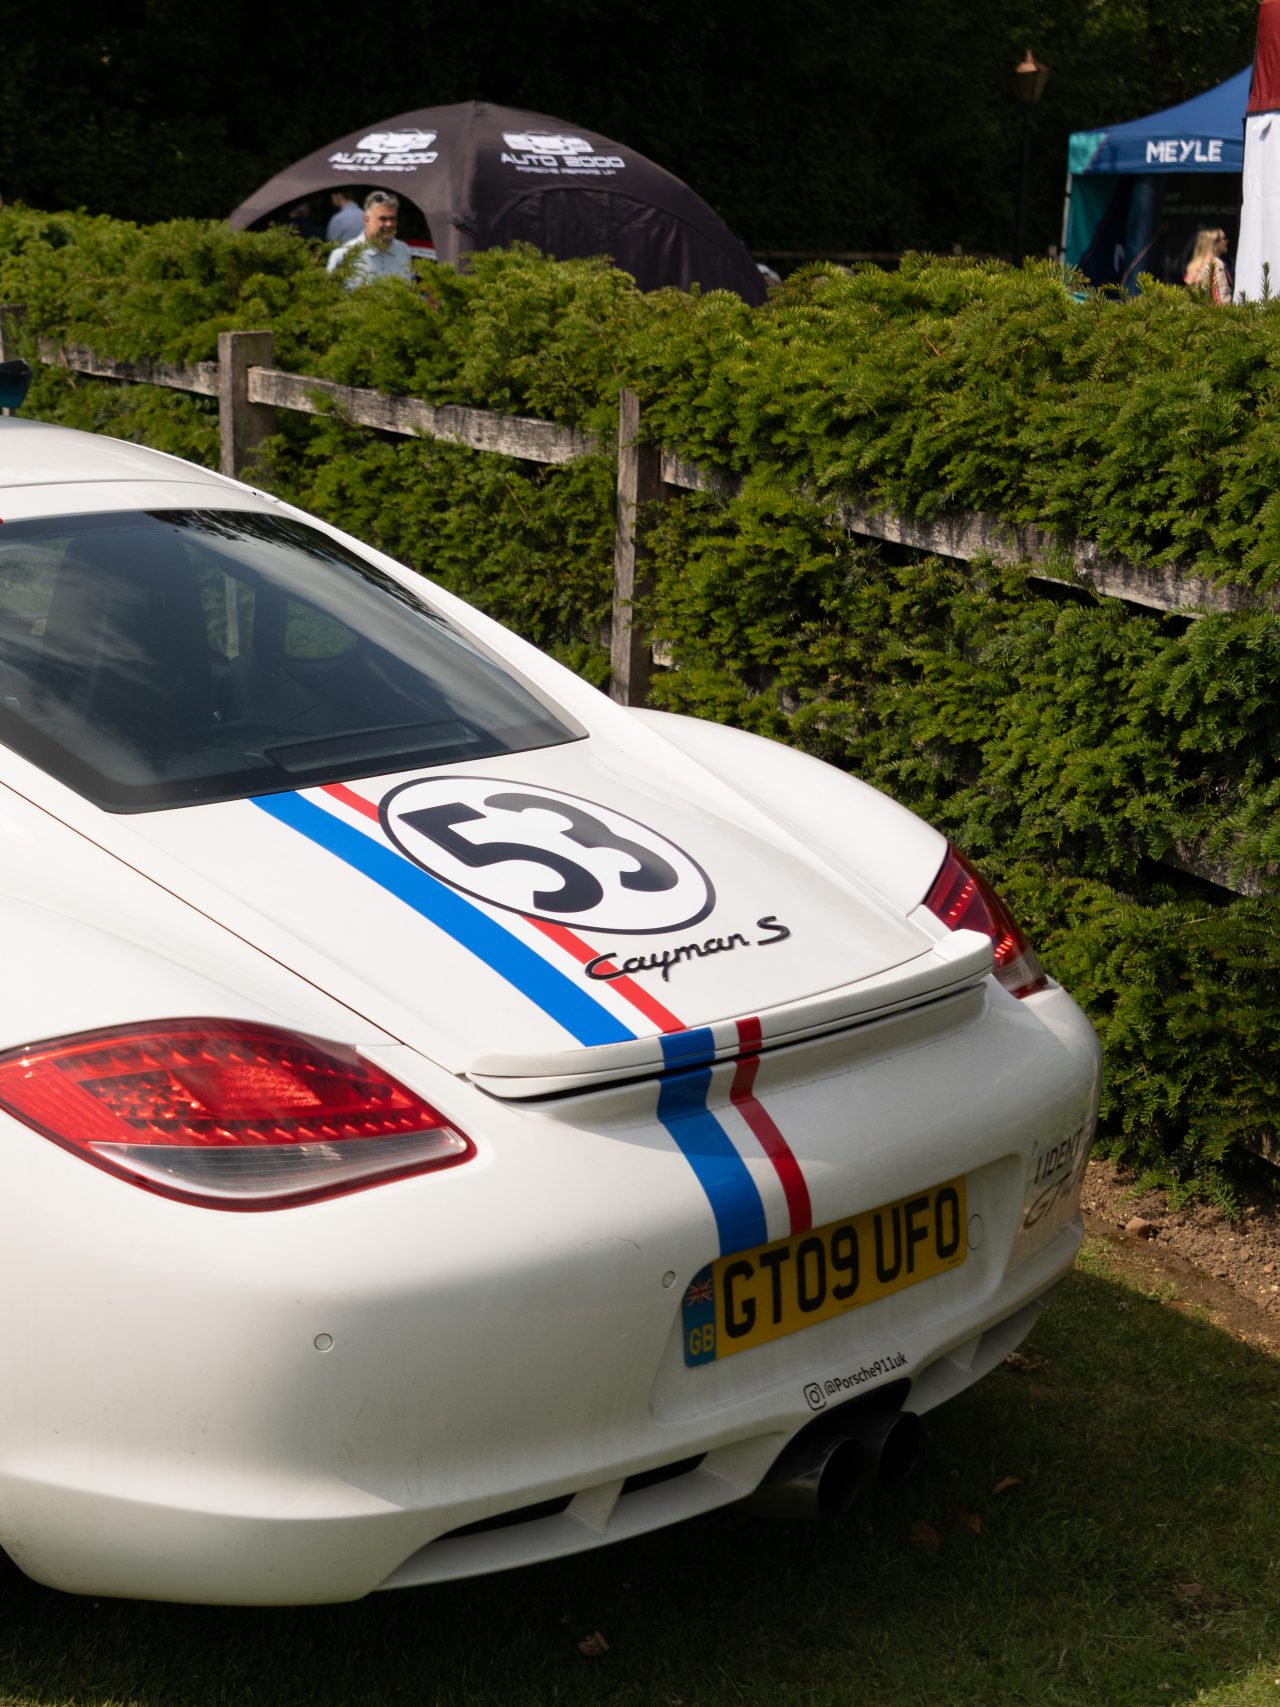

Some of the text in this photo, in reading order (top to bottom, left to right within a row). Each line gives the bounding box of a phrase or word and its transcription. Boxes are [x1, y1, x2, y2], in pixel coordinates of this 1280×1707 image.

[327, 151, 439, 165] AUTO 2000
[500, 152, 626, 168] AUTO 2000
[1145, 139, 1224, 163] MEYLE
[396, 792, 680, 914] 53
[584, 915, 791, 983] Cayman S
[722, 1186, 961, 1339] GT09 UFO
[689, 1323, 715, 1357] GB
[823, 1351, 909, 1397] @Porsche911uk
